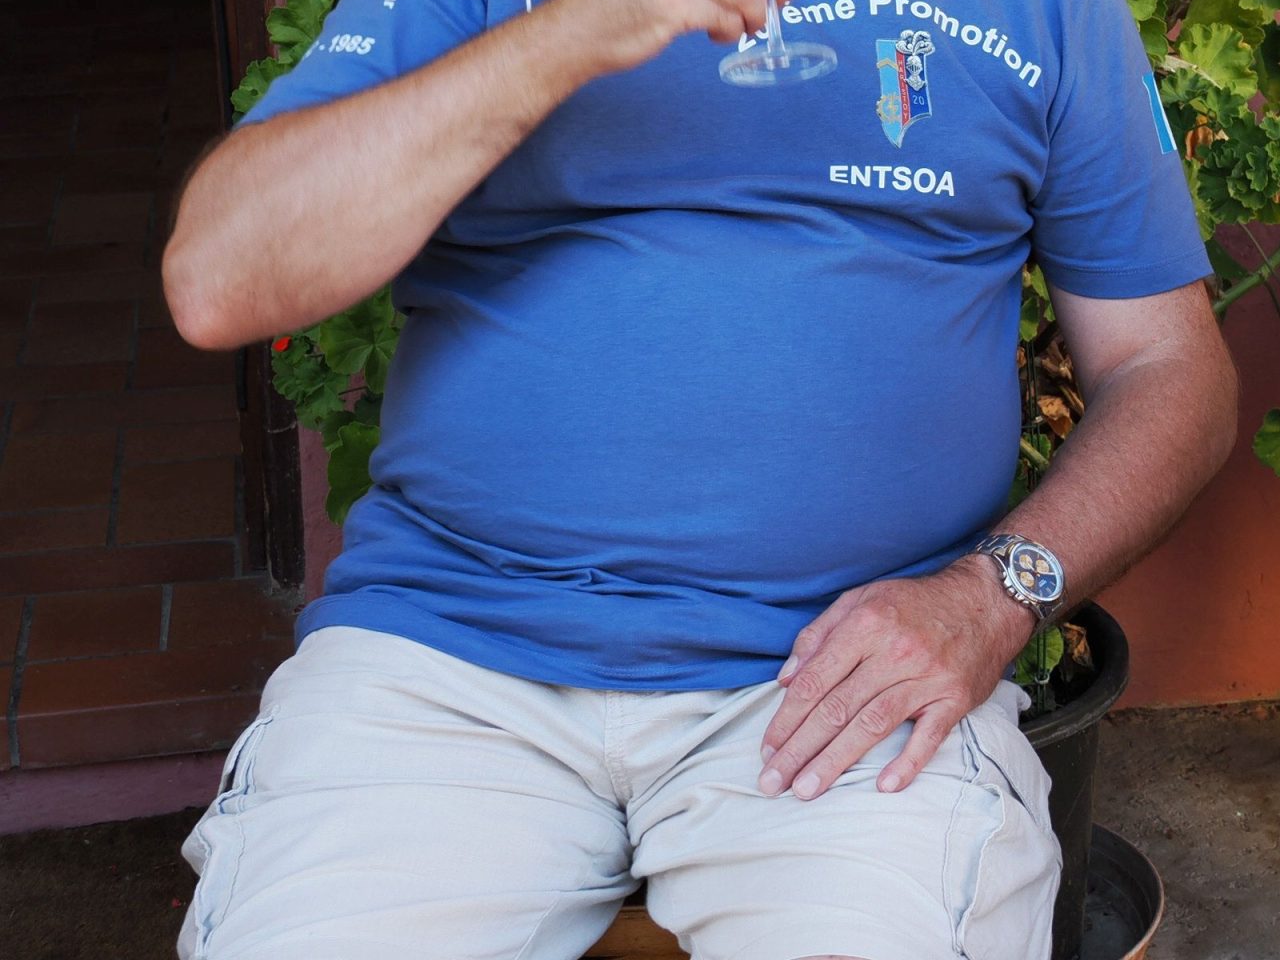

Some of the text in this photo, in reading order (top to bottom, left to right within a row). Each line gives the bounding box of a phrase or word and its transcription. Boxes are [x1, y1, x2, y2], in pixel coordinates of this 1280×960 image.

[328, 33, 376, 55] 1985
[912, 95, 926, 106] 20
[829, 165, 956, 198] ENTSOA
